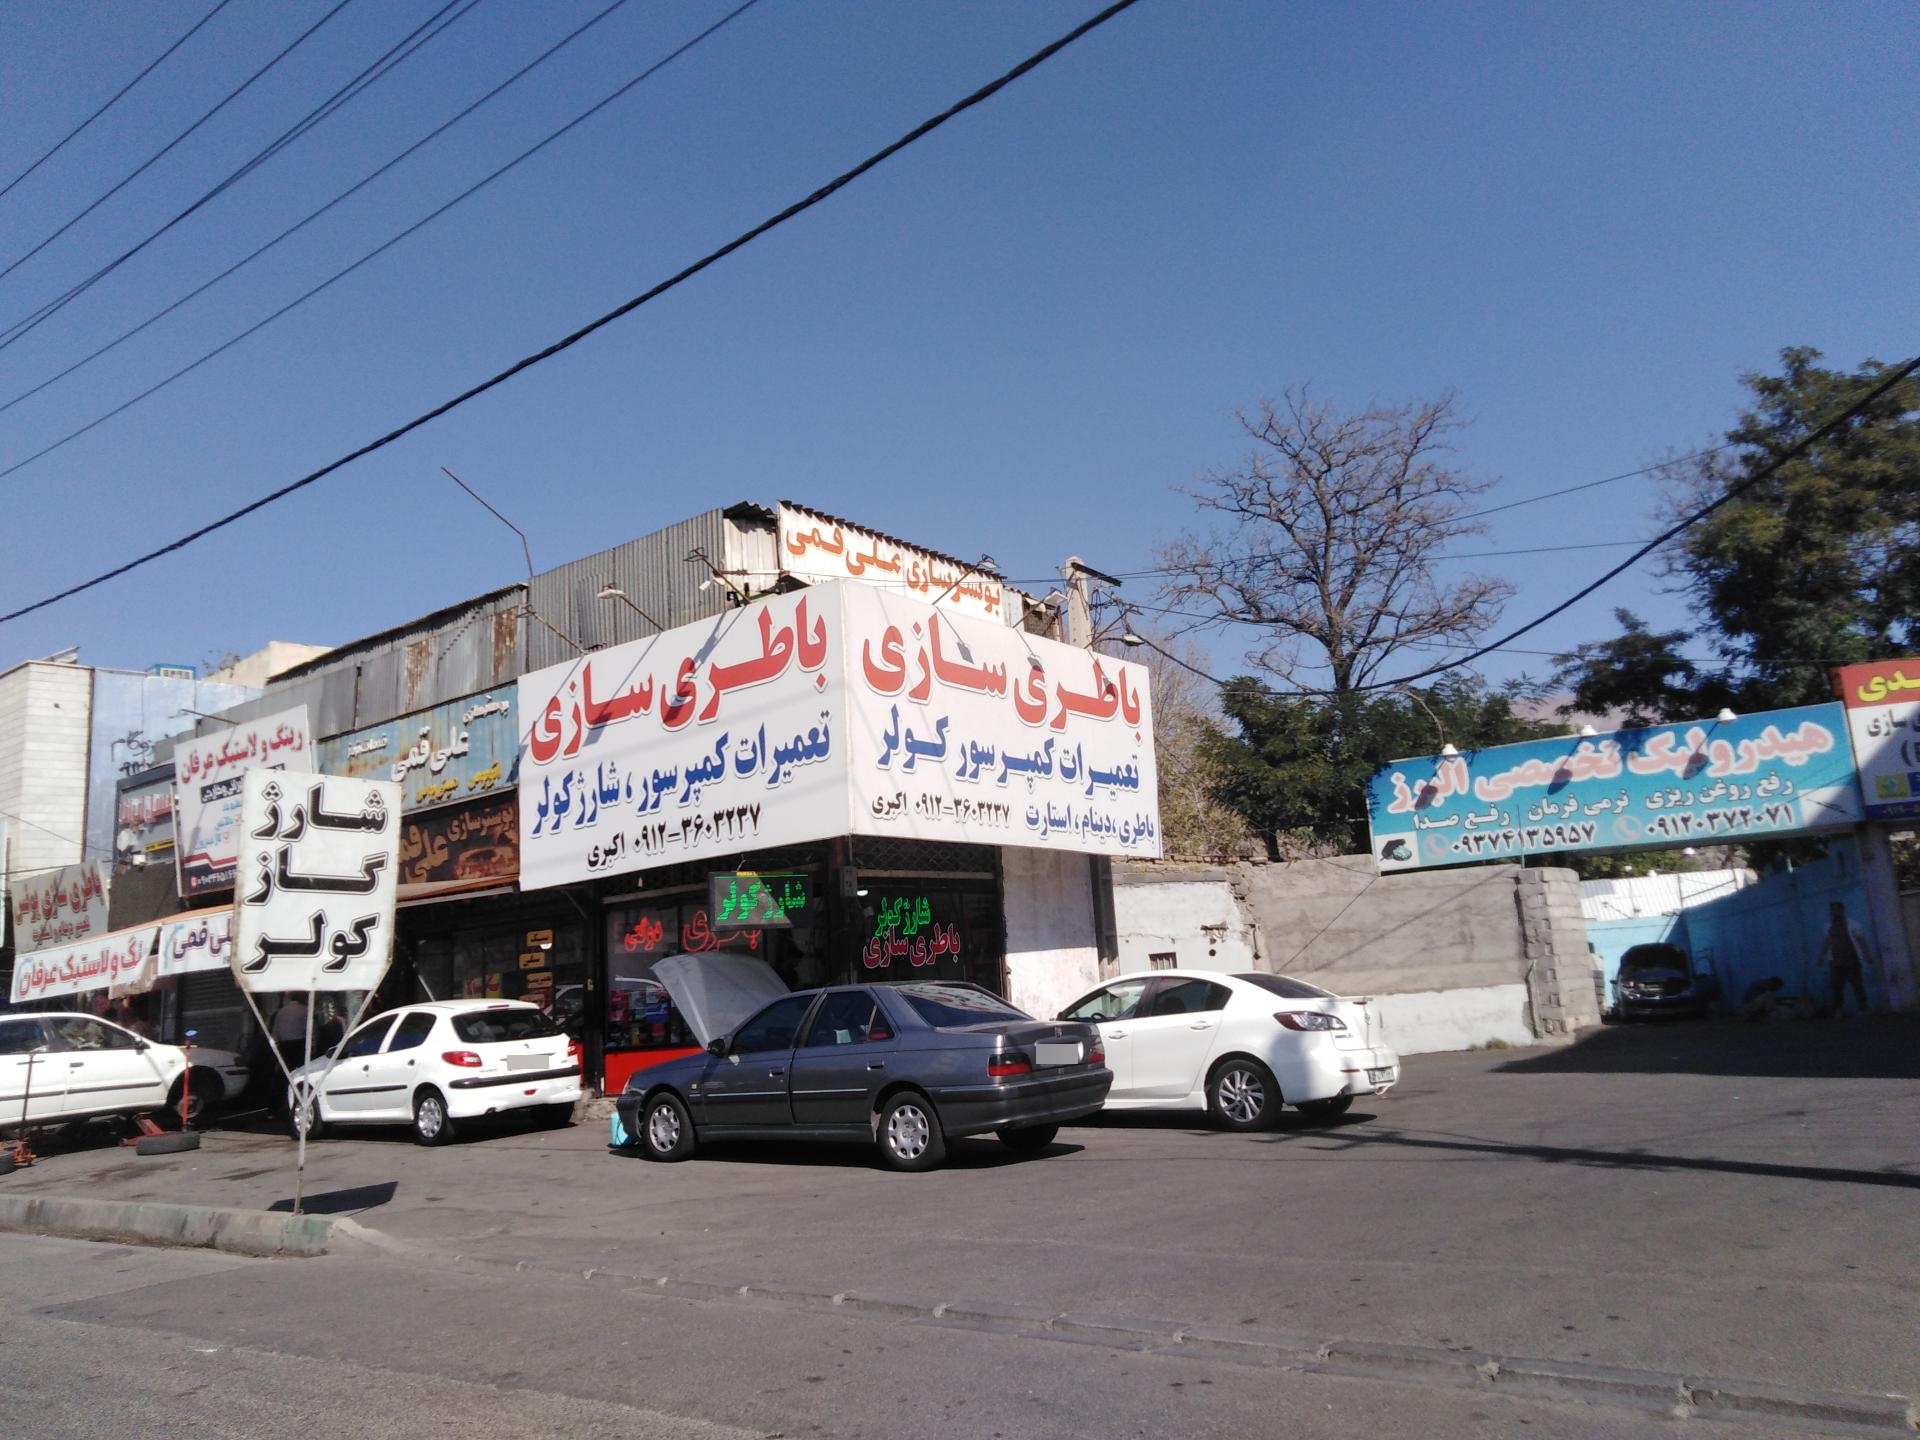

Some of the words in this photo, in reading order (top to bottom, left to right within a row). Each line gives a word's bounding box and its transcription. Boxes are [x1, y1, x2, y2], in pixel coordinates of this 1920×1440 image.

[846, 540, 901, 576] علی
[660, 594, 827, 729] باطری
[862, 612, 1007, 701] سازی
[1014, 658, 1142, 743] باطری
[1858, 670, 1920, 702] دی
[531, 662, 653, 762] سازی
[217, 730, 257, 770] لاستیک
[260, 740, 268, 762] و
[269, 723, 303, 752] رینگ
[430, 726, 469, 771] علی
[735, 710, 830, 785] تعمیرات
[877, 703, 949, 769] کولر
[1628, 722, 1833, 777] هیدرولیک
[181, 751, 213, 784] عرفان
[956, 737, 1054, 791] کمپرسور
[1060, 743, 1140, 796] تعمیرات
[1475, 740, 1622, 802] تخصصی
[1757, 771, 1794, 797] رفع
[532, 770, 574, 835] کولر
[575, 762, 620, 826] شارژ
[872, 791, 907, 816] اکبری
[1388, 757, 1469, 814] البرز
[1583, 787, 1630, 816] نرمی
[1646, 789, 1693, 810] ریزی
[1700, 778, 1751, 803] روغن
[251, 780, 388, 842] شارژ
[1025, 803, 1071, 837] استارت
[1413, 812, 1460, 831] صدا
[1464, 803, 1510, 831] رفع
[1528, 794, 1579, 822] فرمان
[588, 831, 625, 868] اکبری
[243, 844, 389, 906] گاز
[716, 881, 762, 921] کولر
[763, 881, 806, 920] شارژ
[875, 897, 903, 937] کولر
[903, 897, 931, 935] شارژ
[210, 917, 233, 955] لی
[241, 909, 381, 975] کولر
[863, 924, 909, 969] سازی
[909, 922, 961, 967] باطری
[19, 959, 58, 996] عرفان
[59, 949, 111, 988] لاستیک
[110, 952, 119, 980] و
